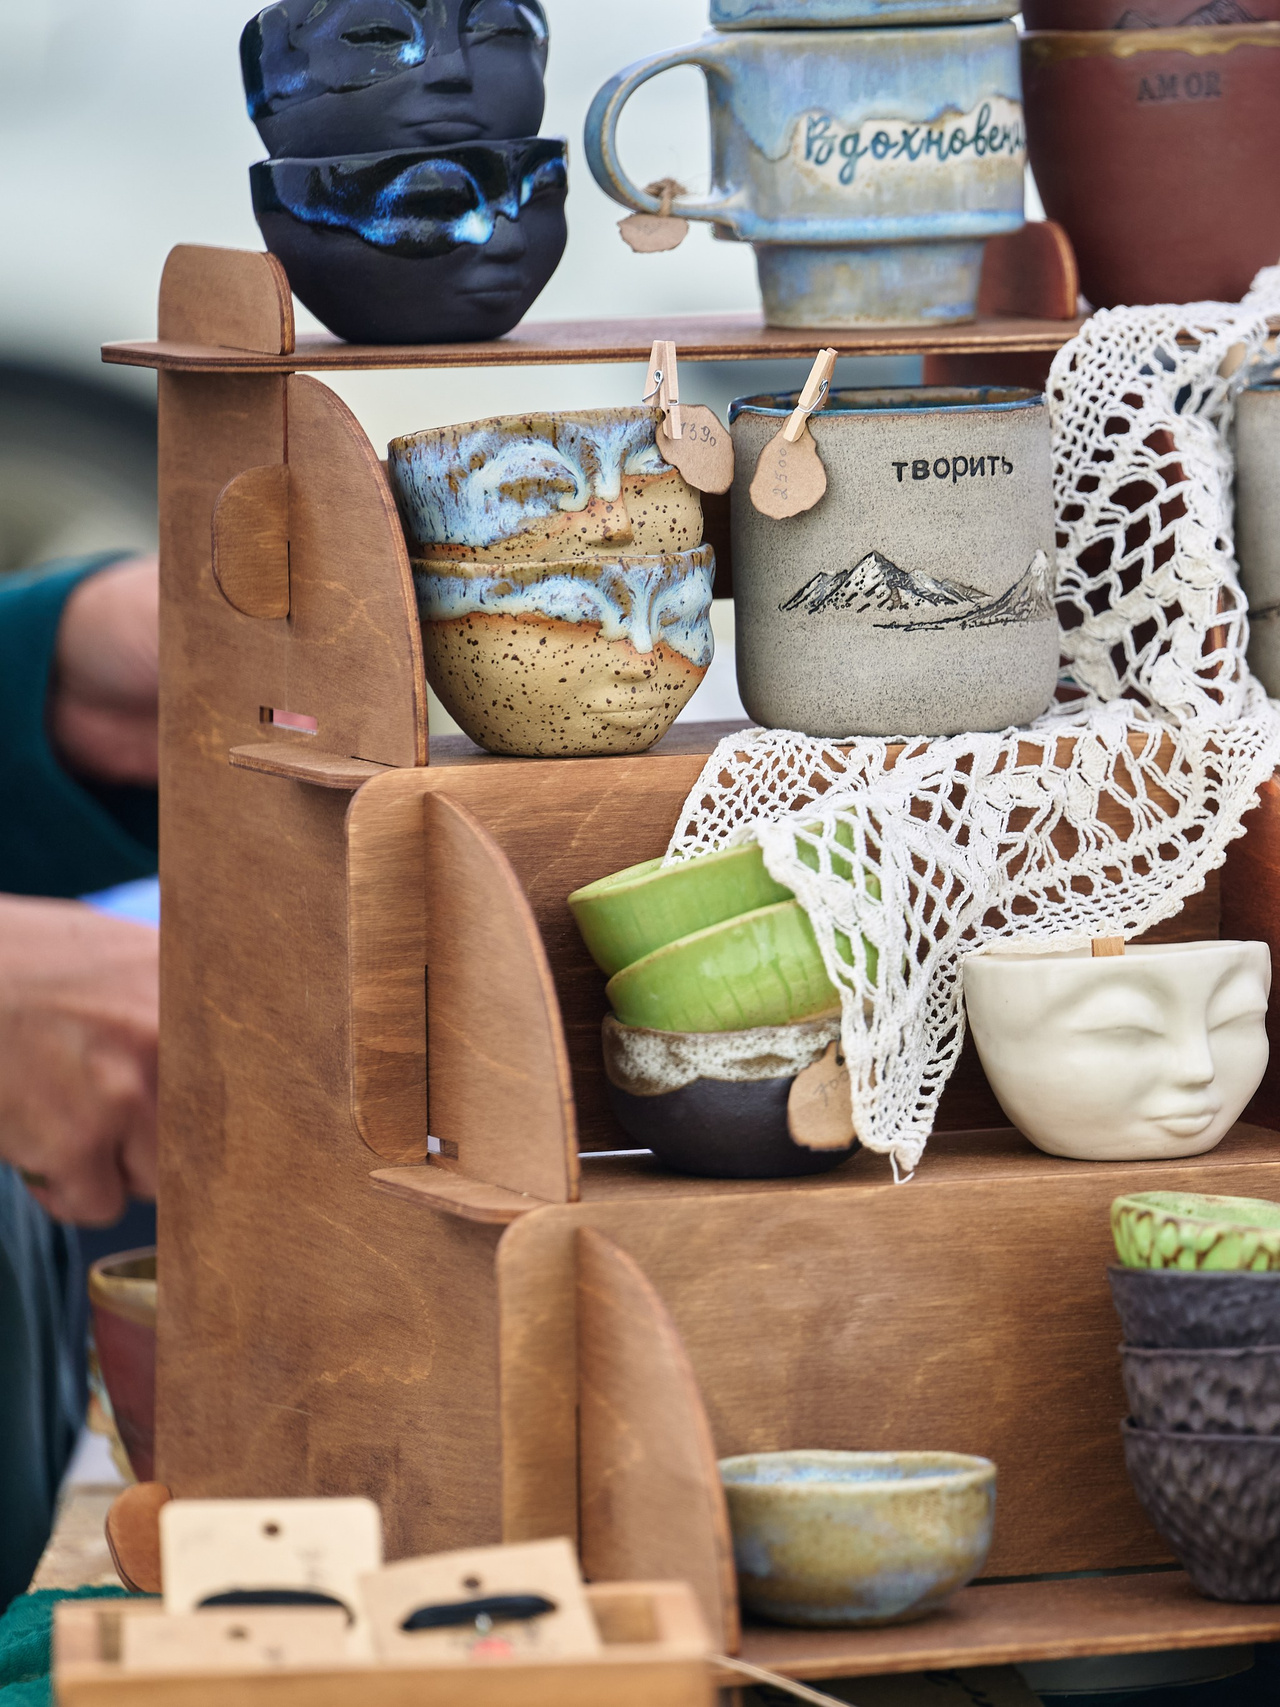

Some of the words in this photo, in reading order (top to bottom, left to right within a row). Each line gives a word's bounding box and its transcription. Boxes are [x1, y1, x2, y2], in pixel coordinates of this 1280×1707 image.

[1136, 70, 1222, 101] AMOR
[680, 421, 717, 447] 1390
[772, 447, 789, 501] 2500
[891, 455, 1014, 484] творить
